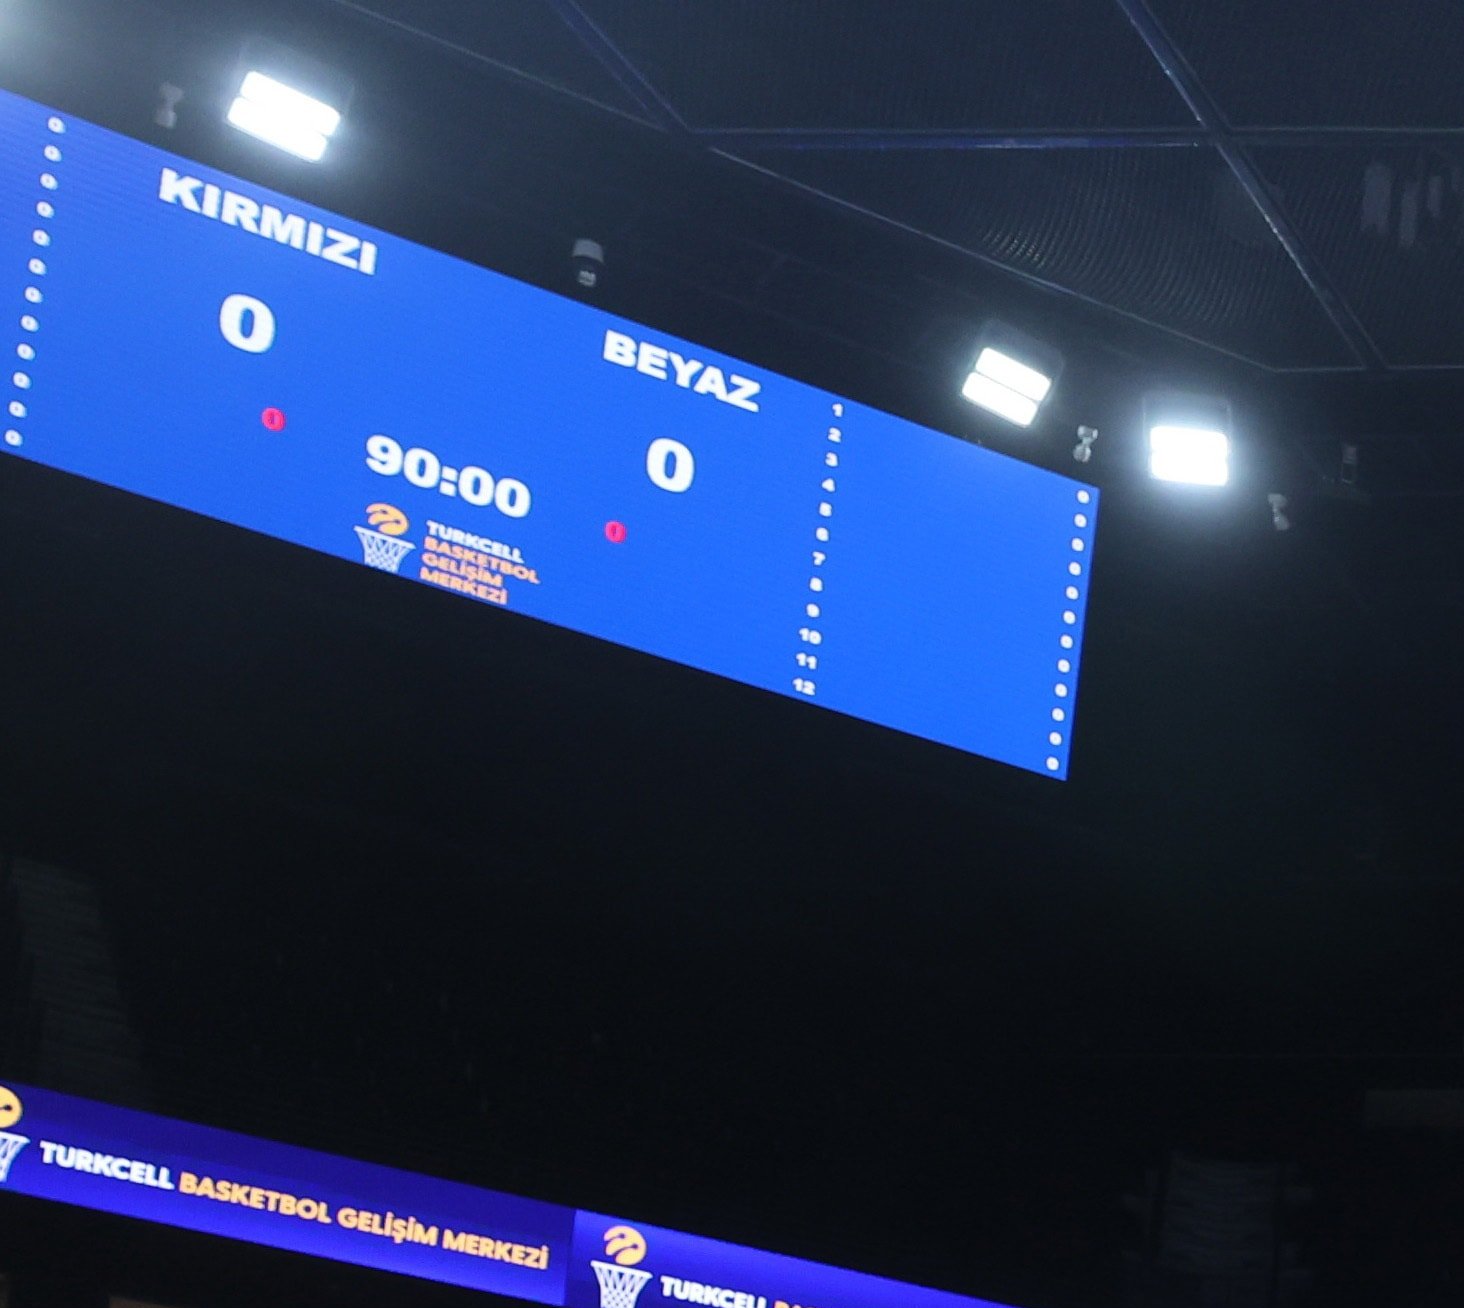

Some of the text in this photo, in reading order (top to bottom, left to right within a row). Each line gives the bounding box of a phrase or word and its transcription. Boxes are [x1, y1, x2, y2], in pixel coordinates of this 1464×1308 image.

[159, 167, 377, 275] KIRMIZI
[219, 294, 275, 353] 0
[603, 330, 761, 412] BEYAZ
[366, 435, 532, 518] 90:00
[646, 438, 694, 492] 0
[425, 519, 525, 564] TURKCELL
[39, 1140, 549, 1270] TURKCELL BASKETBOL GELİŞİM MERKEZİ
